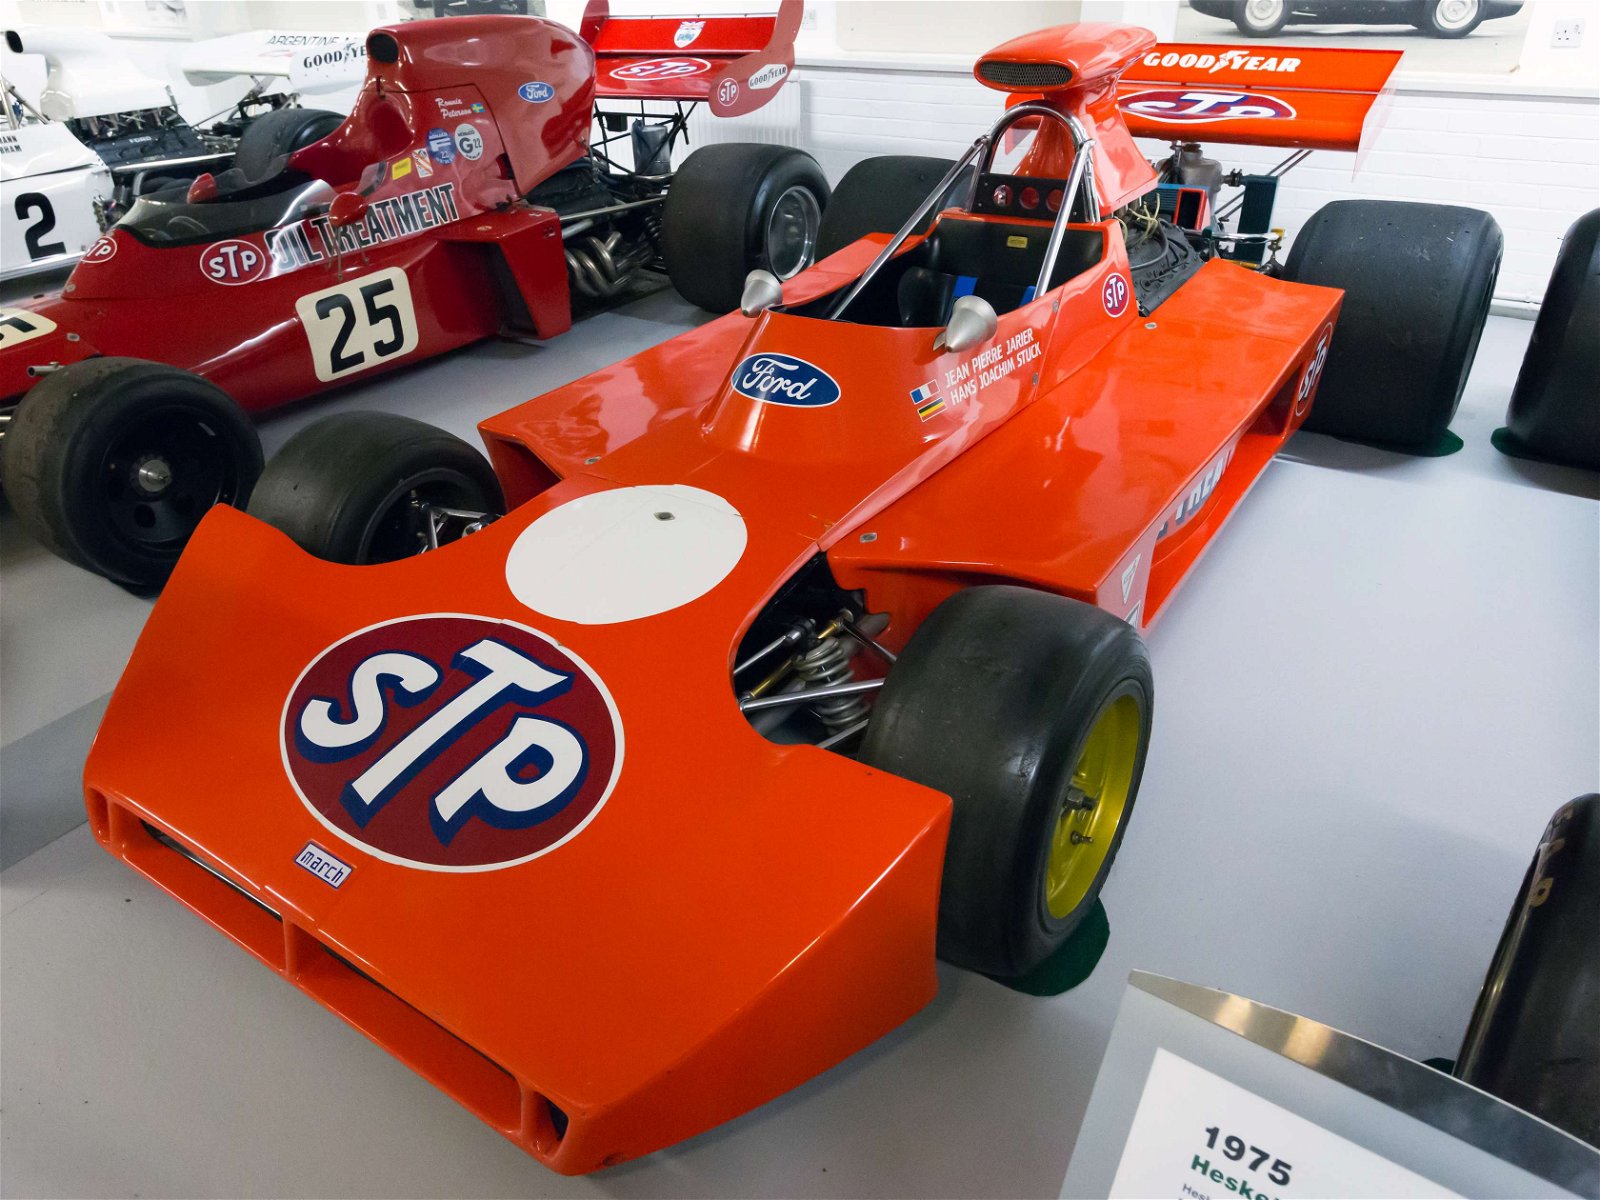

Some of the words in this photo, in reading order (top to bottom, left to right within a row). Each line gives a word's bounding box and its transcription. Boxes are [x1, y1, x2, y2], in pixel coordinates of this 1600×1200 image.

[303, 43, 367, 69] GOODYE
[618, 61, 698, 76] STP
[1143, 49, 1301, 74] GOODYEAR
[525, 84, 549, 99] Ford
[720, 81, 737, 102] STP
[750, 66, 787, 87] GOODYEAR
[14, 192, 67, 262] 2
[264, 221, 325, 271] OIL
[311, 182, 460, 258] TREATMENT
[209, 245, 258, 279] STP
[1105, 276, 1126, 309] STP
[315, 278, 405, 374] 25
[944, 362, 970, 388] JEAN
[971, 344, 1004, 373] PIERRE
[1006, 327, 1034, 355] JARIER
[950, 379, 977, 406] HANS
[978, 357, 1016, 390] JOACHIM
[1016, 342, 1042, 367] STUCK
[1298, 335, 1328, 402] STP
[742, 357, 818, 400] Ford
[296, 637, 589, 847] STP
[300, 851, 344, 883] march
[1205, 1126, 1292, 1186] 1975
